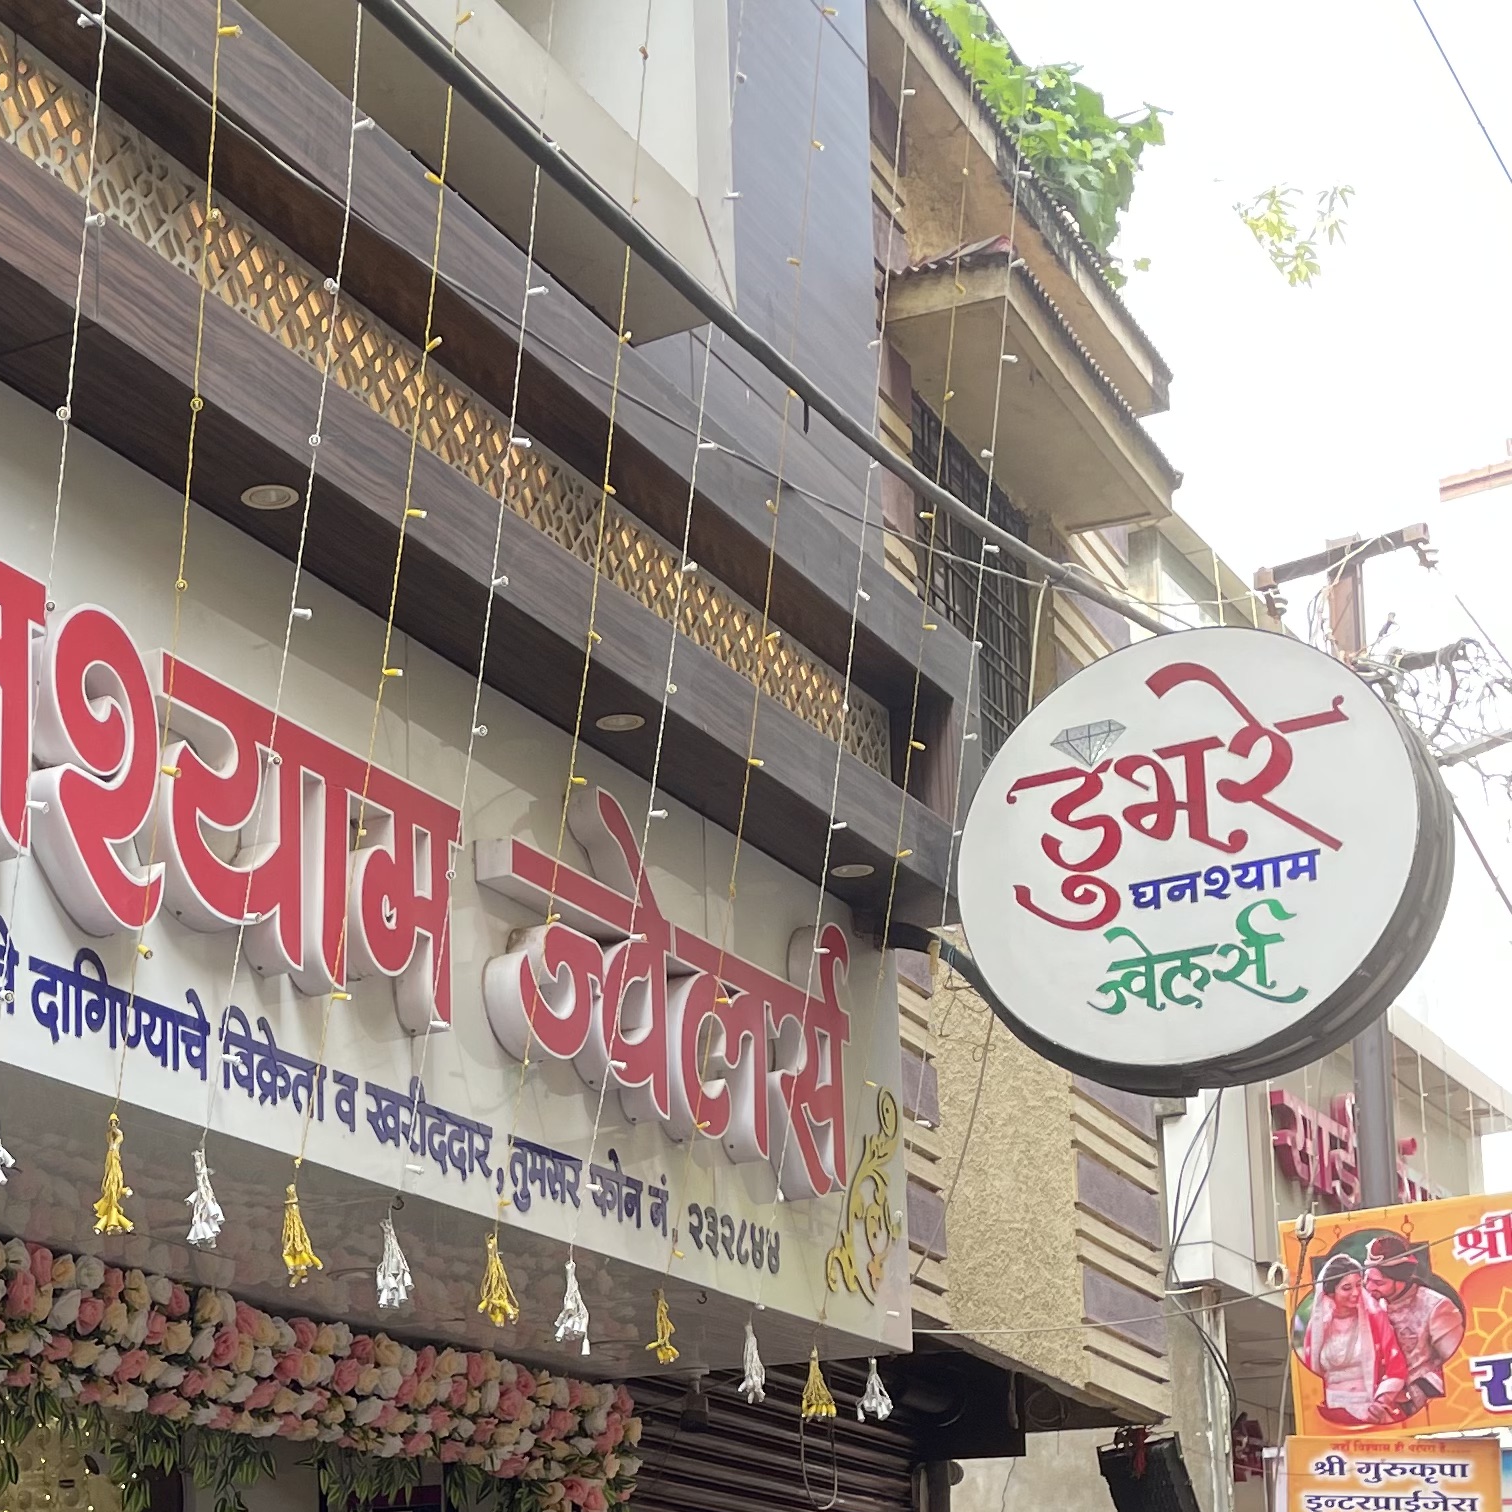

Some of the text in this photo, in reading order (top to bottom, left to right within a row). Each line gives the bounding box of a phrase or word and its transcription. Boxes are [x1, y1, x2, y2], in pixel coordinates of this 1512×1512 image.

[1128, 847, 1321, 912] घनश्याम
[476, 786, 850, 1199] ज्वेलर्स
[28, 947, 211, 1081] दागिण्याचे
[218, 1004, 327, 1122] विक्रेता
[332, 1068, 360, 1133] व
[507, 1133, 583, 1213] तुमसर
[688, 1202, 781, 1275] २३२८४४
[1314, 1454, 1347, 1477] श्री
